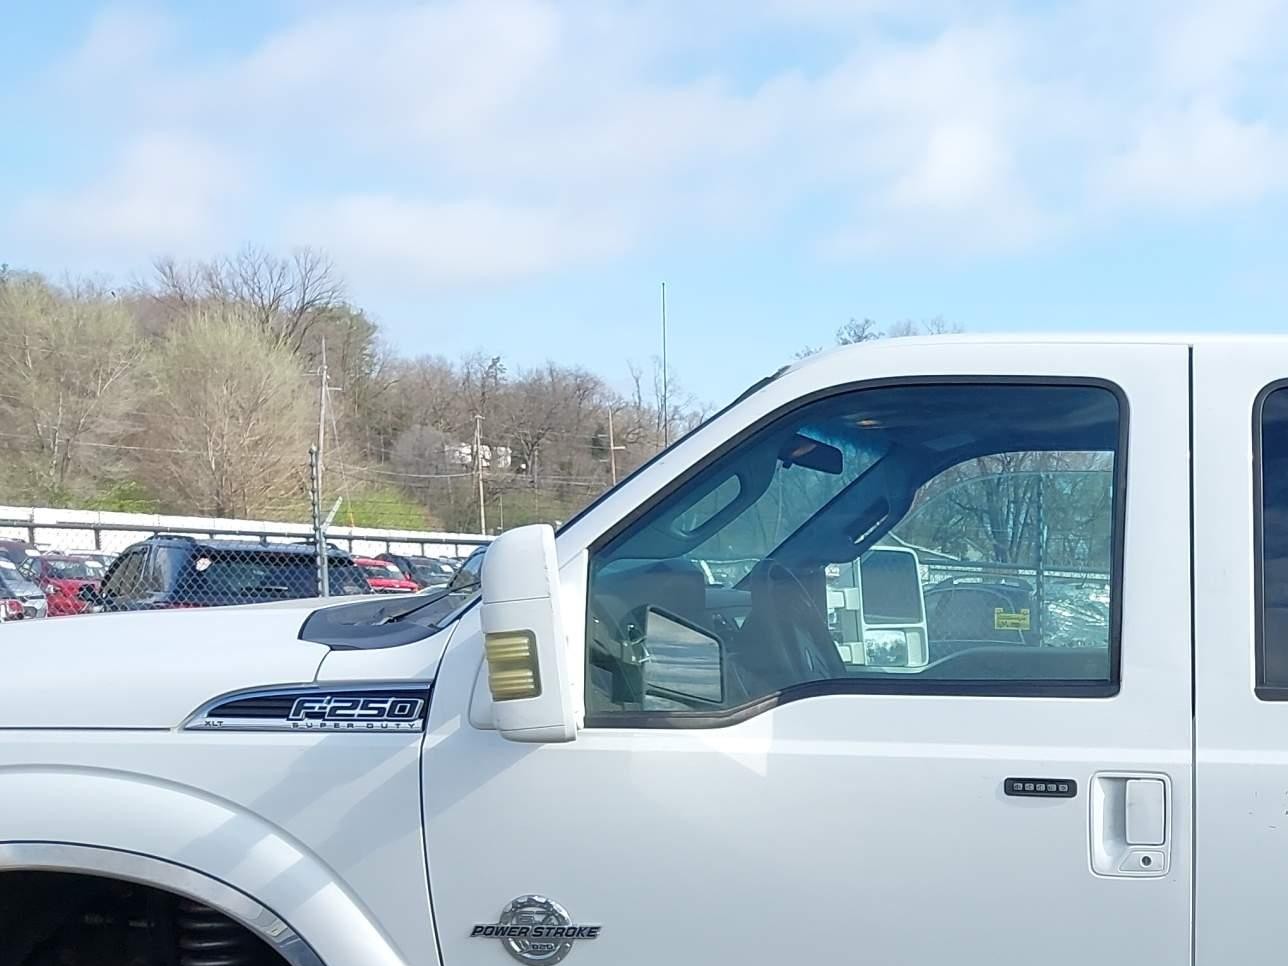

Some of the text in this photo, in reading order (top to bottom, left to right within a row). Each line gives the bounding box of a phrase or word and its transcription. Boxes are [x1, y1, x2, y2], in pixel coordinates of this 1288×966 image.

[287, 696, 424, 720] F-250
[471, 925, 601, 938] POWER STROKE
